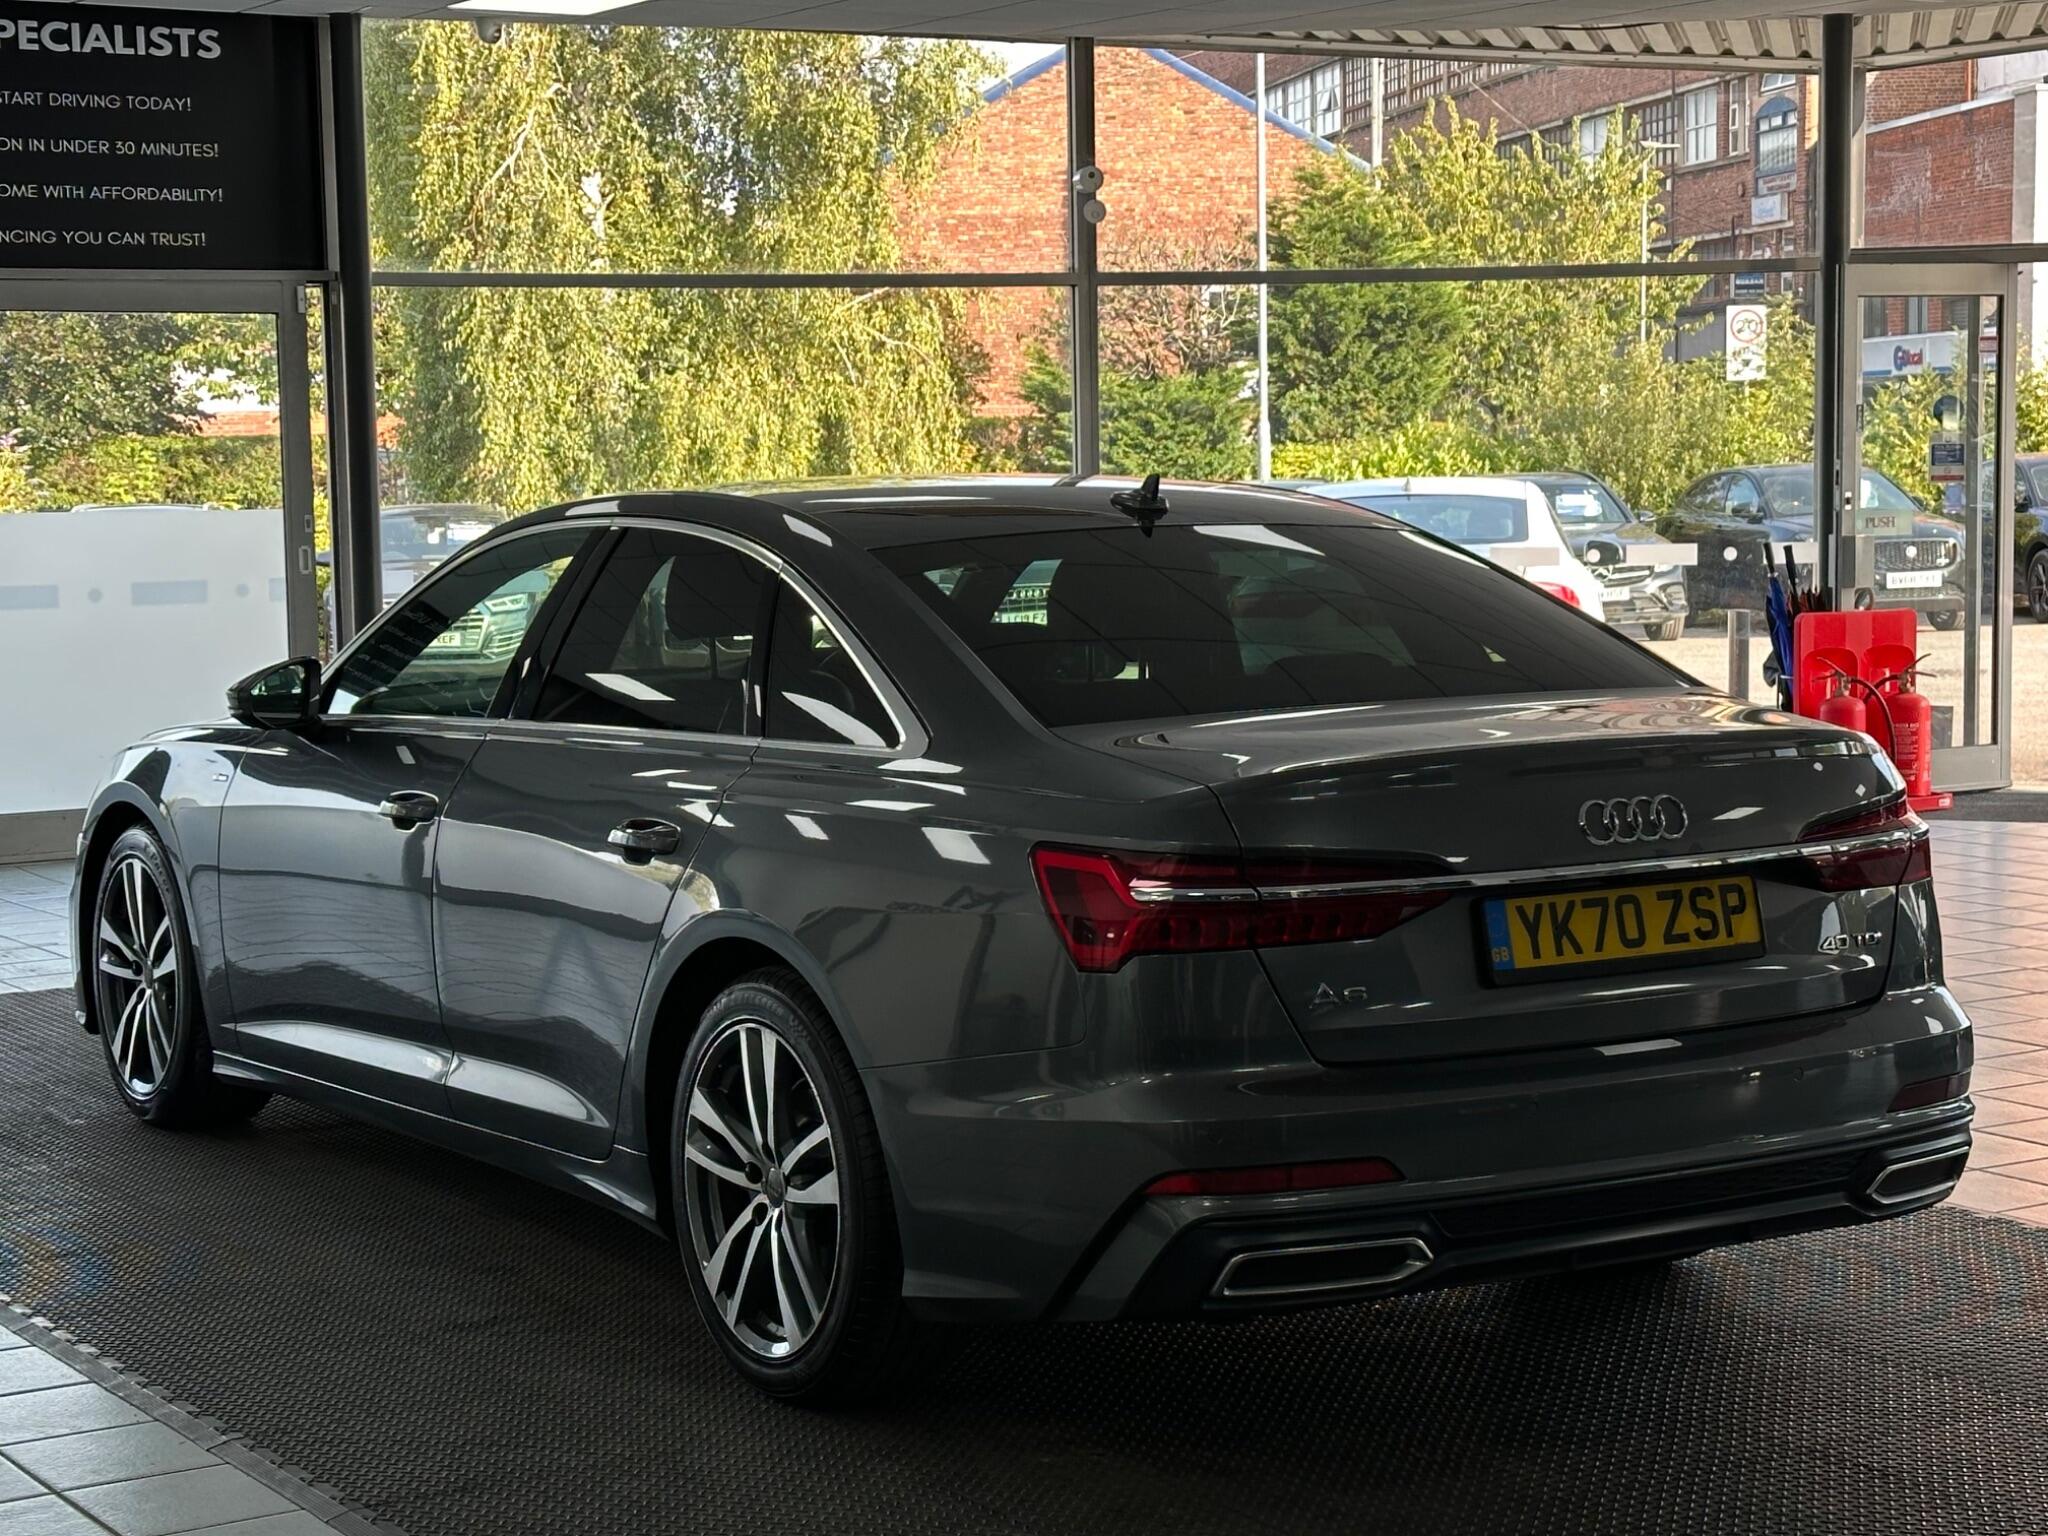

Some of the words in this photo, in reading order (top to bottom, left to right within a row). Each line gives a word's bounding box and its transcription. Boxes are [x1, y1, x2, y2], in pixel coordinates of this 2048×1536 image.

[0, 19, 221, 59] PECIALISTS
[0, 91, 43, 106] TART
[49, 93, 120, 109] DRIVING
[126, 95, 191, 111] TODAY!
[29, 138, 44, 153] IN
[51, 140, 109, 154] UNDER
[115, 141, 135, 155] 30
[141, 143, 218, 157] MINUTES!
[43, 186, 84, 199] WITH
[90, 187, 223, 202] AFFORDABILITY!
[63, 231, 102, 245] YOU
[108, 232, 145, 245] CAN
[150, 233, 206, 246] TRUST!
[1865, 516, 1896, 528] PUSH
[1515, 894, 1647, 960] YK70
[1656, 883, 1747, 946] ZSP
[1822, 934, 1849, 950] 40
[1491, 947, 1510, 962] GB
